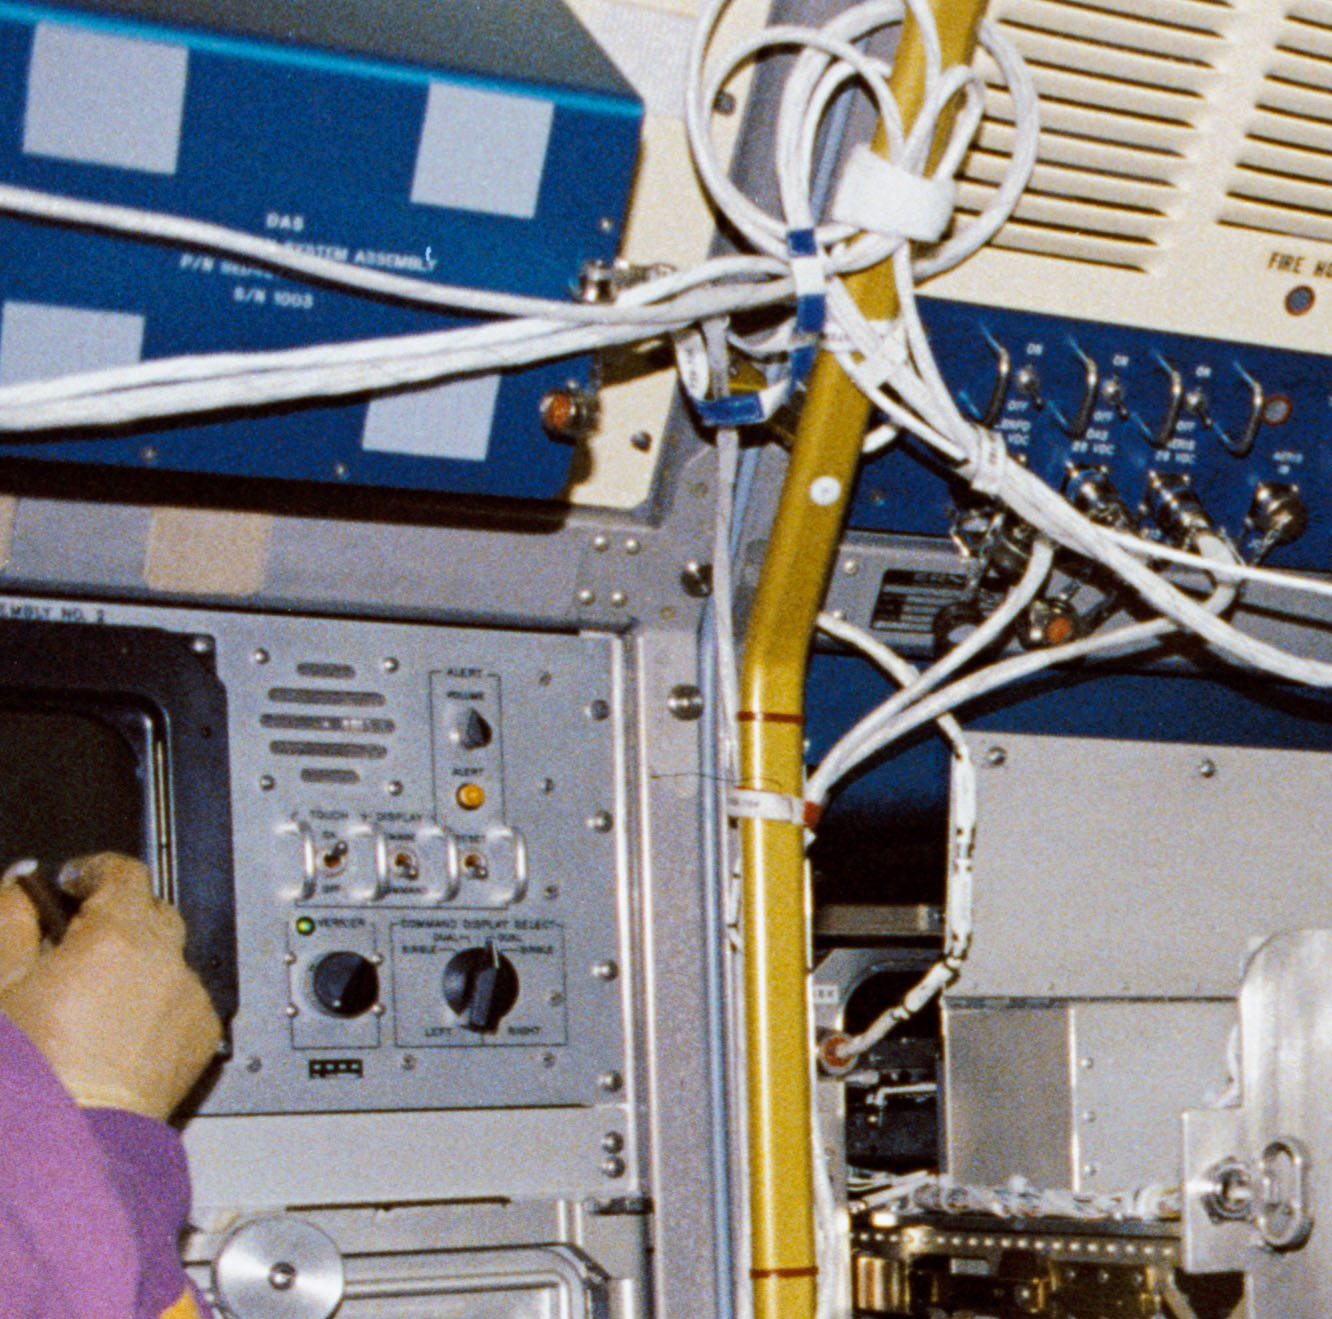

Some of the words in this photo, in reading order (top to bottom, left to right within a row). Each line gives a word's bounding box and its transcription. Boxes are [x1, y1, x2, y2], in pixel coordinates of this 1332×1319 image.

[265, 212, 305, 232] DAS
[179, 253, 215, 273] P/N
[354, 249, 438, 273] ASSEMBLY
[1268, 251, 1305, 275] FIRE
[233, 286, 267, 305] S/N
[273, 290, 314, 309] 1003
[1026, 342, 1044, 356] ON
[1113, 354, 1130, 368] ON
[1195, 365, 1212, 378] ON
[1007, 399, 1029, 412] OFF
[1093, 410, 1115, 422] OFF
[1175, 420, 1197, 432] OFF
[1086, 427, 1110, 441] DAS
[1093, 443, 1117, 456] VDC
[400, 918, 458, 930] COMMAND
[462, 919, 508, 930] DISPLAY
[514, 918, 556, 930] SELECT
